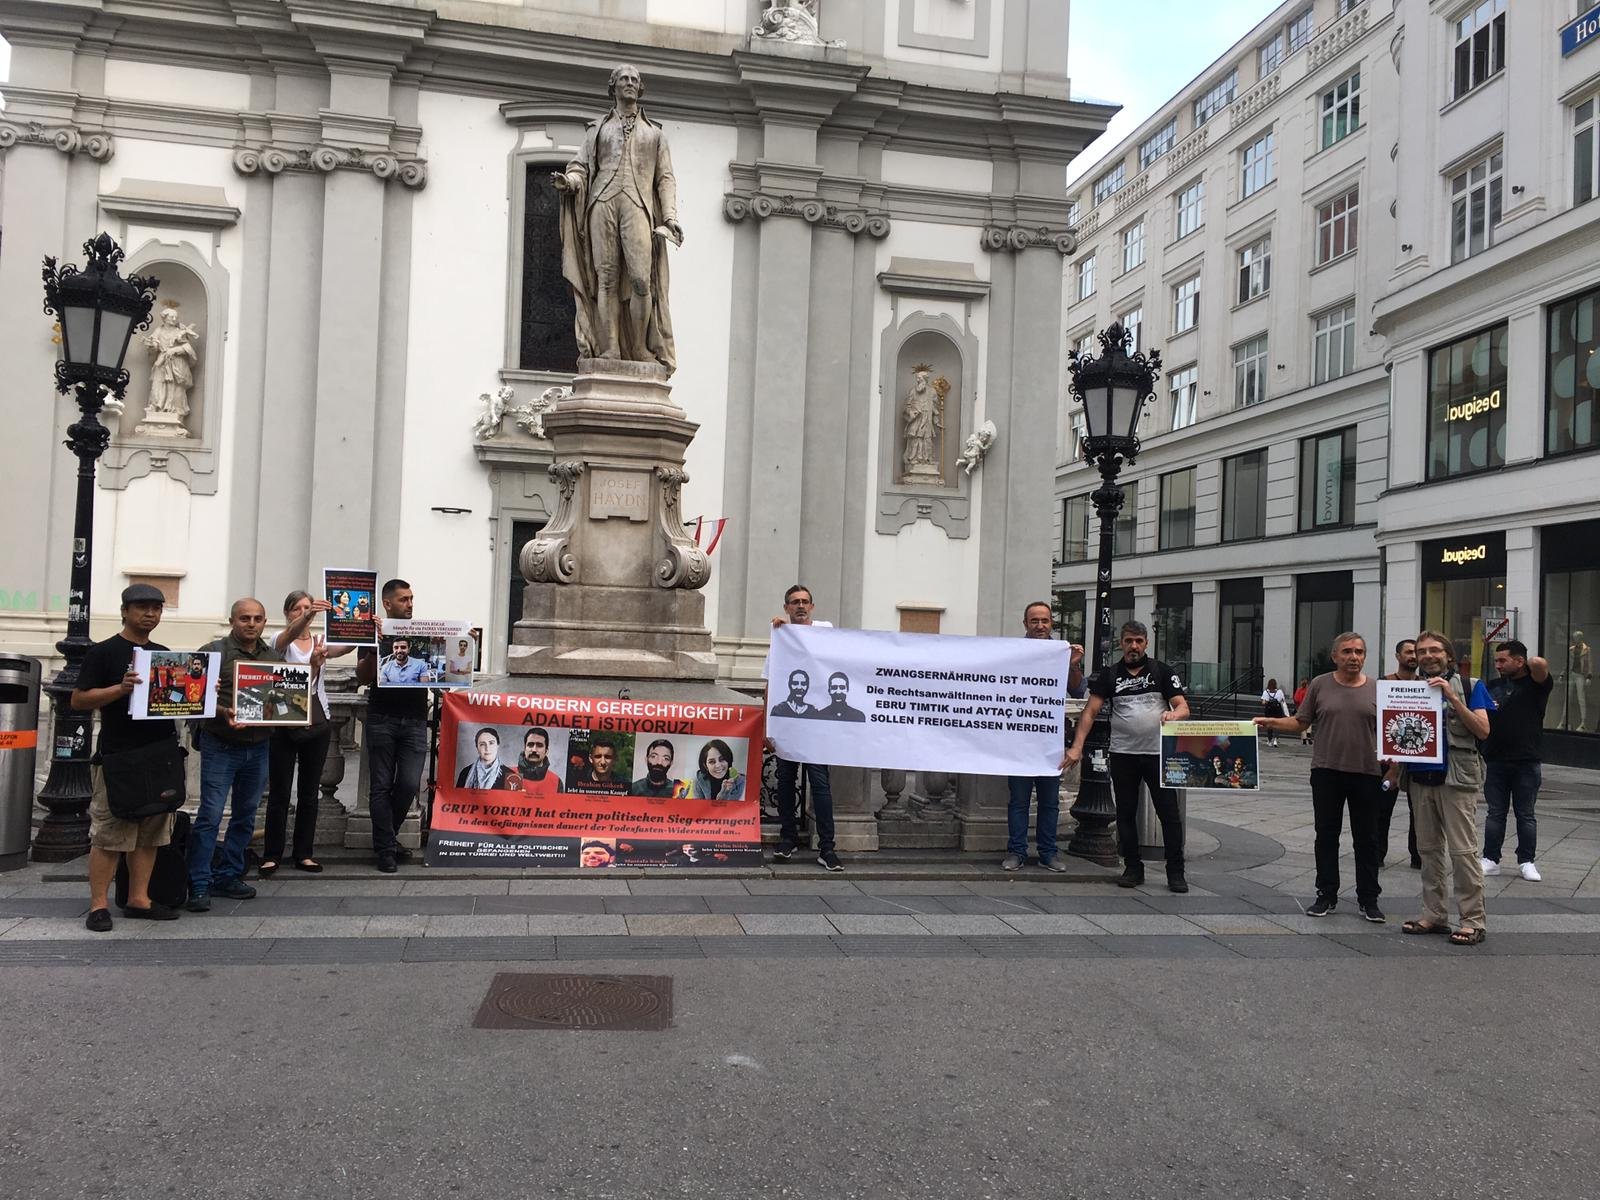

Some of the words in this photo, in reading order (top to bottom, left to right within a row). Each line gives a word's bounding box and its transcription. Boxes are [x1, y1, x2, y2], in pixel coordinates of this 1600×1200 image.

[594, 492, 646, 506] HAYDN
[875, 667, 996, 683] ZWANGSERNÄHRUNG
[1000, 676, 1019, 684] IST
[1021, 678, 1058, 687] MORD!
[866, 685, 884, 695] Die
[887, 687, 993, 702] RechtsanwältInnen
[996, 694, 1006, 702] in
[1009, 695, 1027, 703] der
[1030, 696, 1065, 706] Türkei
[467, 693, 501, 707] WIR
[506, 695, 591, 712] FORDERN
[596, 701, 734, 721] GERECHTIGKEIT
[738, 708, 743, 721] !
[876, 700, 906, 709] EBRU
[909, 702, 949, 713] TIMTIK
[952, 705, 973, 714] und
[975, 706, 1013, 718] AYTAÇ
[1016, 708, 1055, 719] ÜNSAL
[521, 712, 593, 729] ADALET
[870, 714, 914, 724] SOLLEN
[917, 716, 1003, 730] FREIGELASSEN
[1006, 723, 1058, 734] WERDEN!
[441, 803, 479, 814] GRUP
[482, 806, 531, 817] YORUM
[535, 808, 556, 818] hat
[559, 811, 593, 819] einen
[595, 812, 664, 823] politischen
[667, 815, 692, 826] Sieg
[695, 817, 756, 826] errungen!
[471, 818, 490, 826] den
[490, 819, 554, 830] Gefängnissen
[556, 822, 588, 830] dauert
[590, 823, 607, 831] der
[608, 824, 721, 835] Todesfasten-Widerstand
